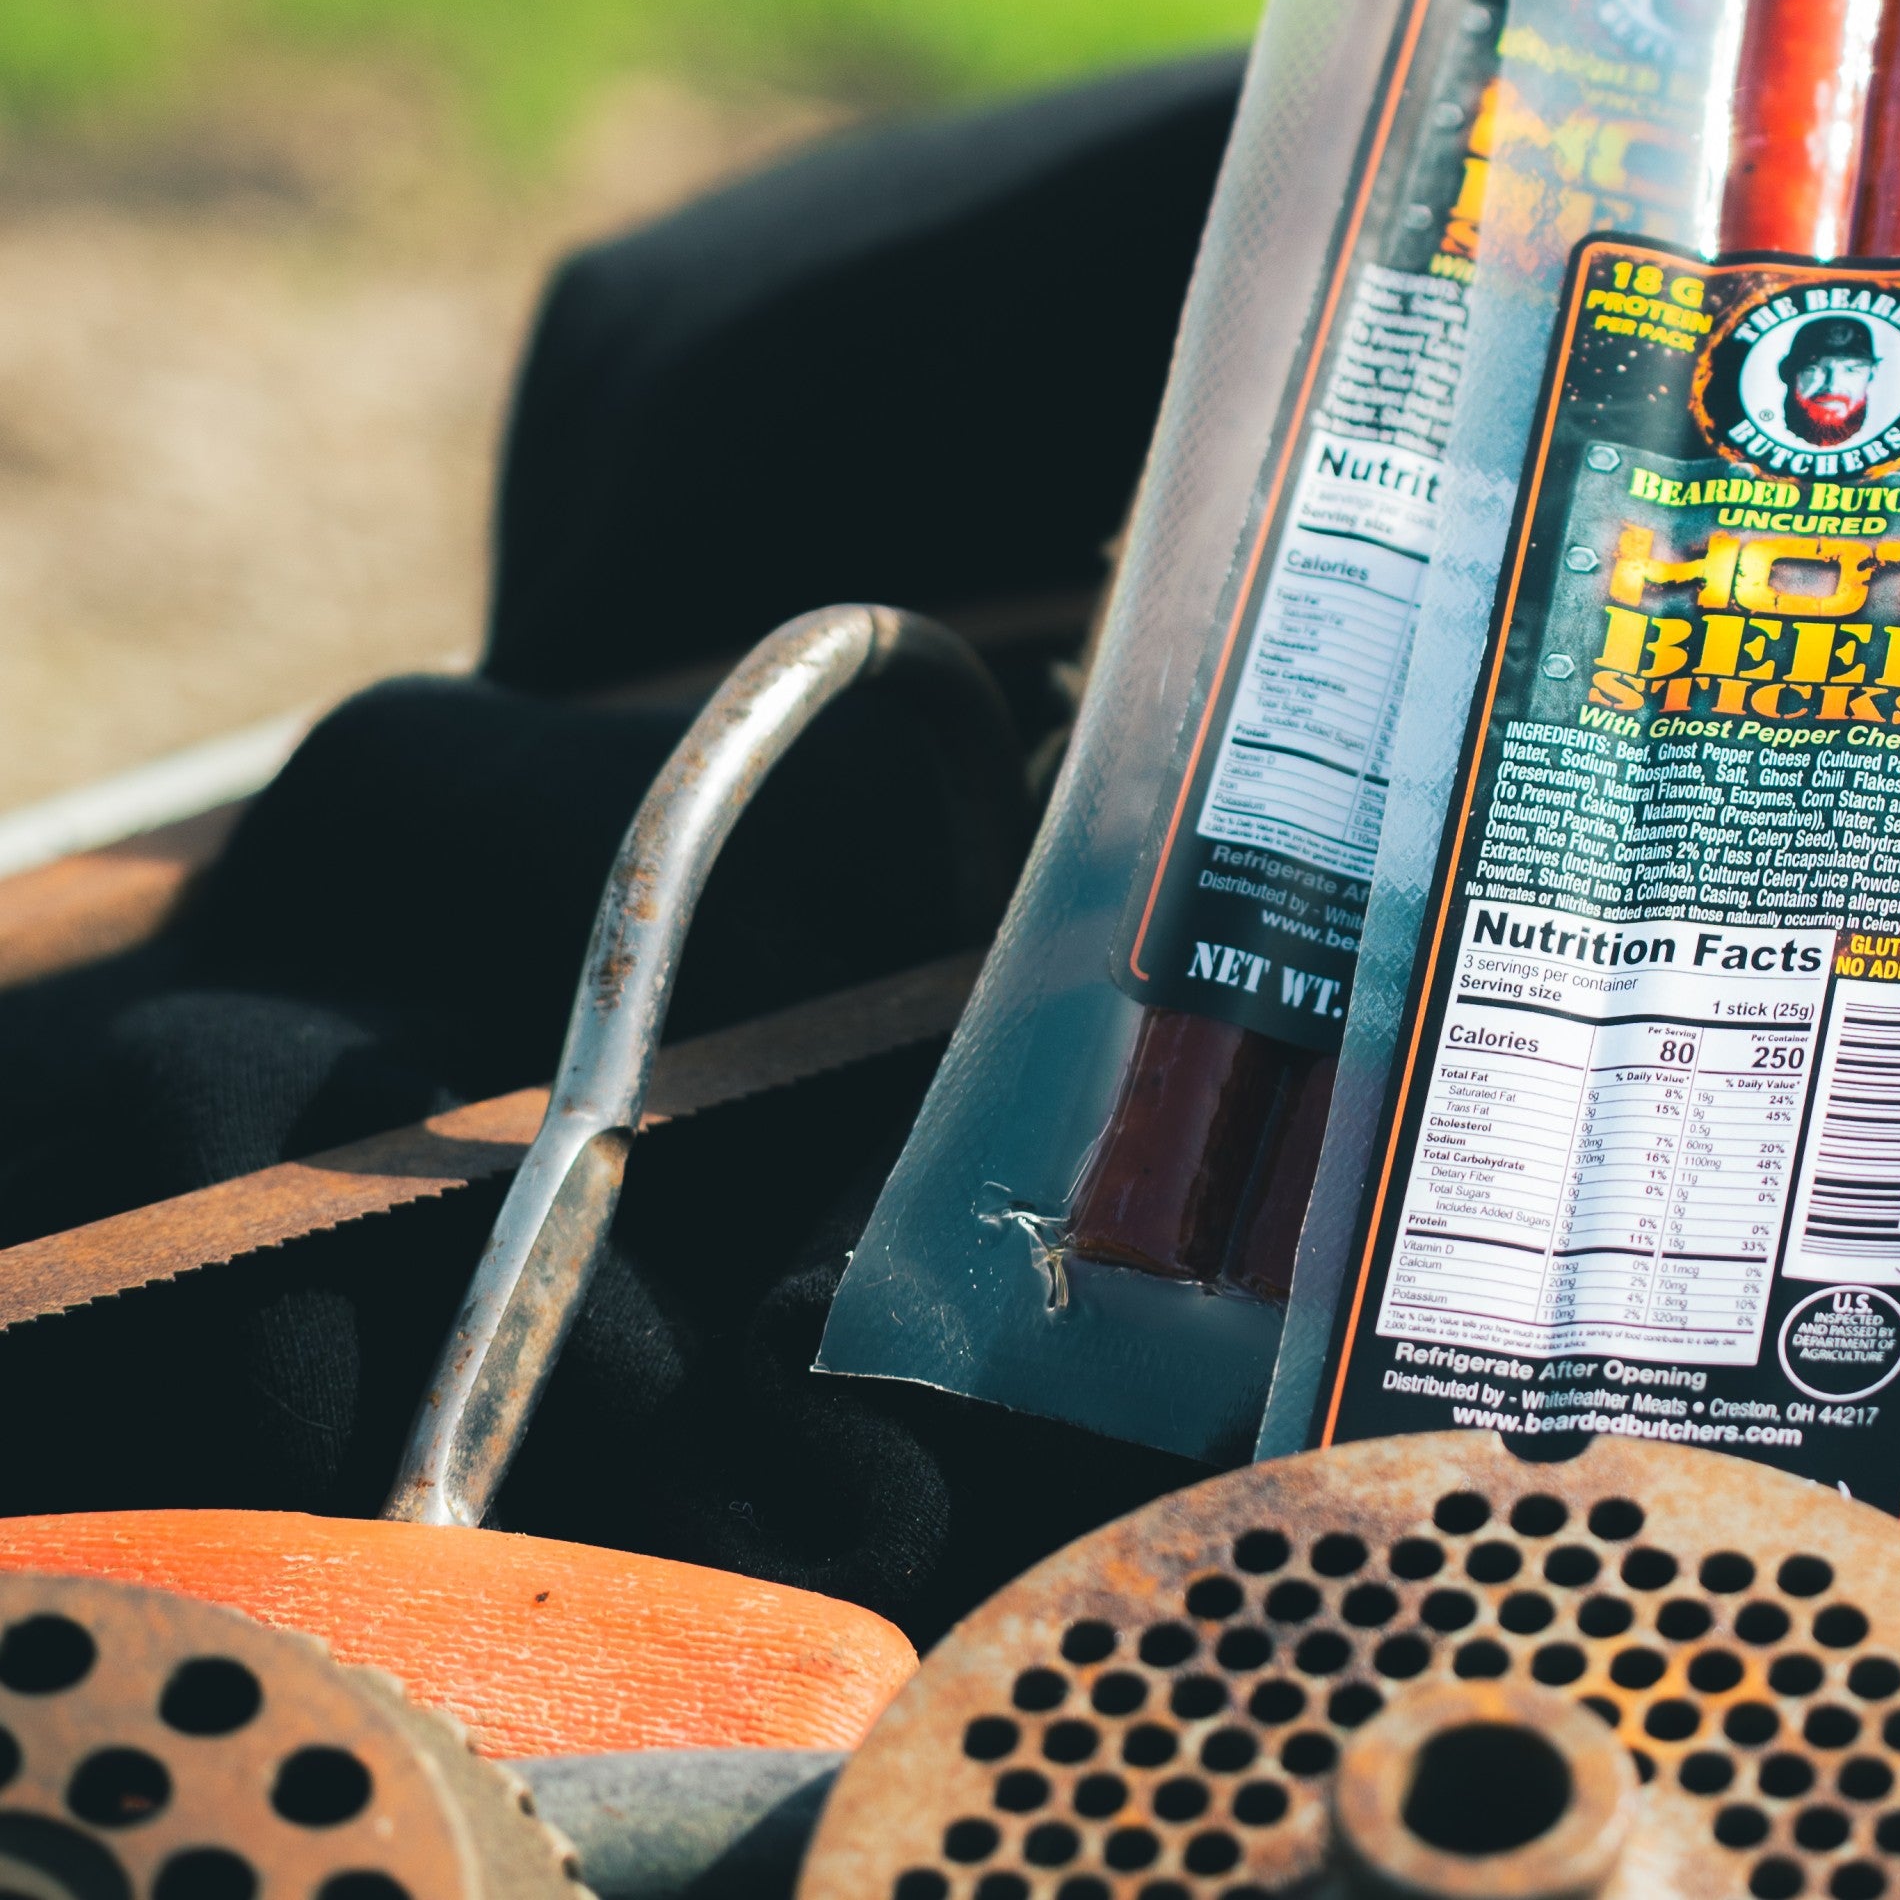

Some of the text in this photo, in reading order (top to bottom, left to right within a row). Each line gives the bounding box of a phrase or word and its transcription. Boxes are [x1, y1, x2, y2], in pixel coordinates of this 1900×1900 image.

[1612, 262, 1706, 307] 18 G
[1586, 290, 1714, 334] PROTEIN
[1595, 315, 1696, 352] PER PACK
[1733, 297, 1797, 345] THE
[1316, 443, 1441, 505] Nutrit
[1628, 466, 1801, 509] BEARDED
[1719, 508, 1889, 535] UNCURED
[1286, 548, 1371, 581] Calories
[1578, 704, 1641, 738] With
[1650, 718, 1733, 738] Ghost
[1737, 720, 1840, 748] Pepper
[1472, 909, 1822, 972] Nutrition Facts
[1187, 941, 1344, 1020] NET WT.
[1460, 974, 1562, 1002] Serving size
[1835, 958, 1866, 976] NO
[1449, 1024, 1805, 1069] Calories 80 250
[1426, 1133, 1466, 1146] Sodium
[1430, 1116, 1492, 1132] Cholesterol
[1394, 1342, 1707, 1391] Refrigerate After Opening
[1453, 1405, 1802, 1446] www.beardedbutchers.com
